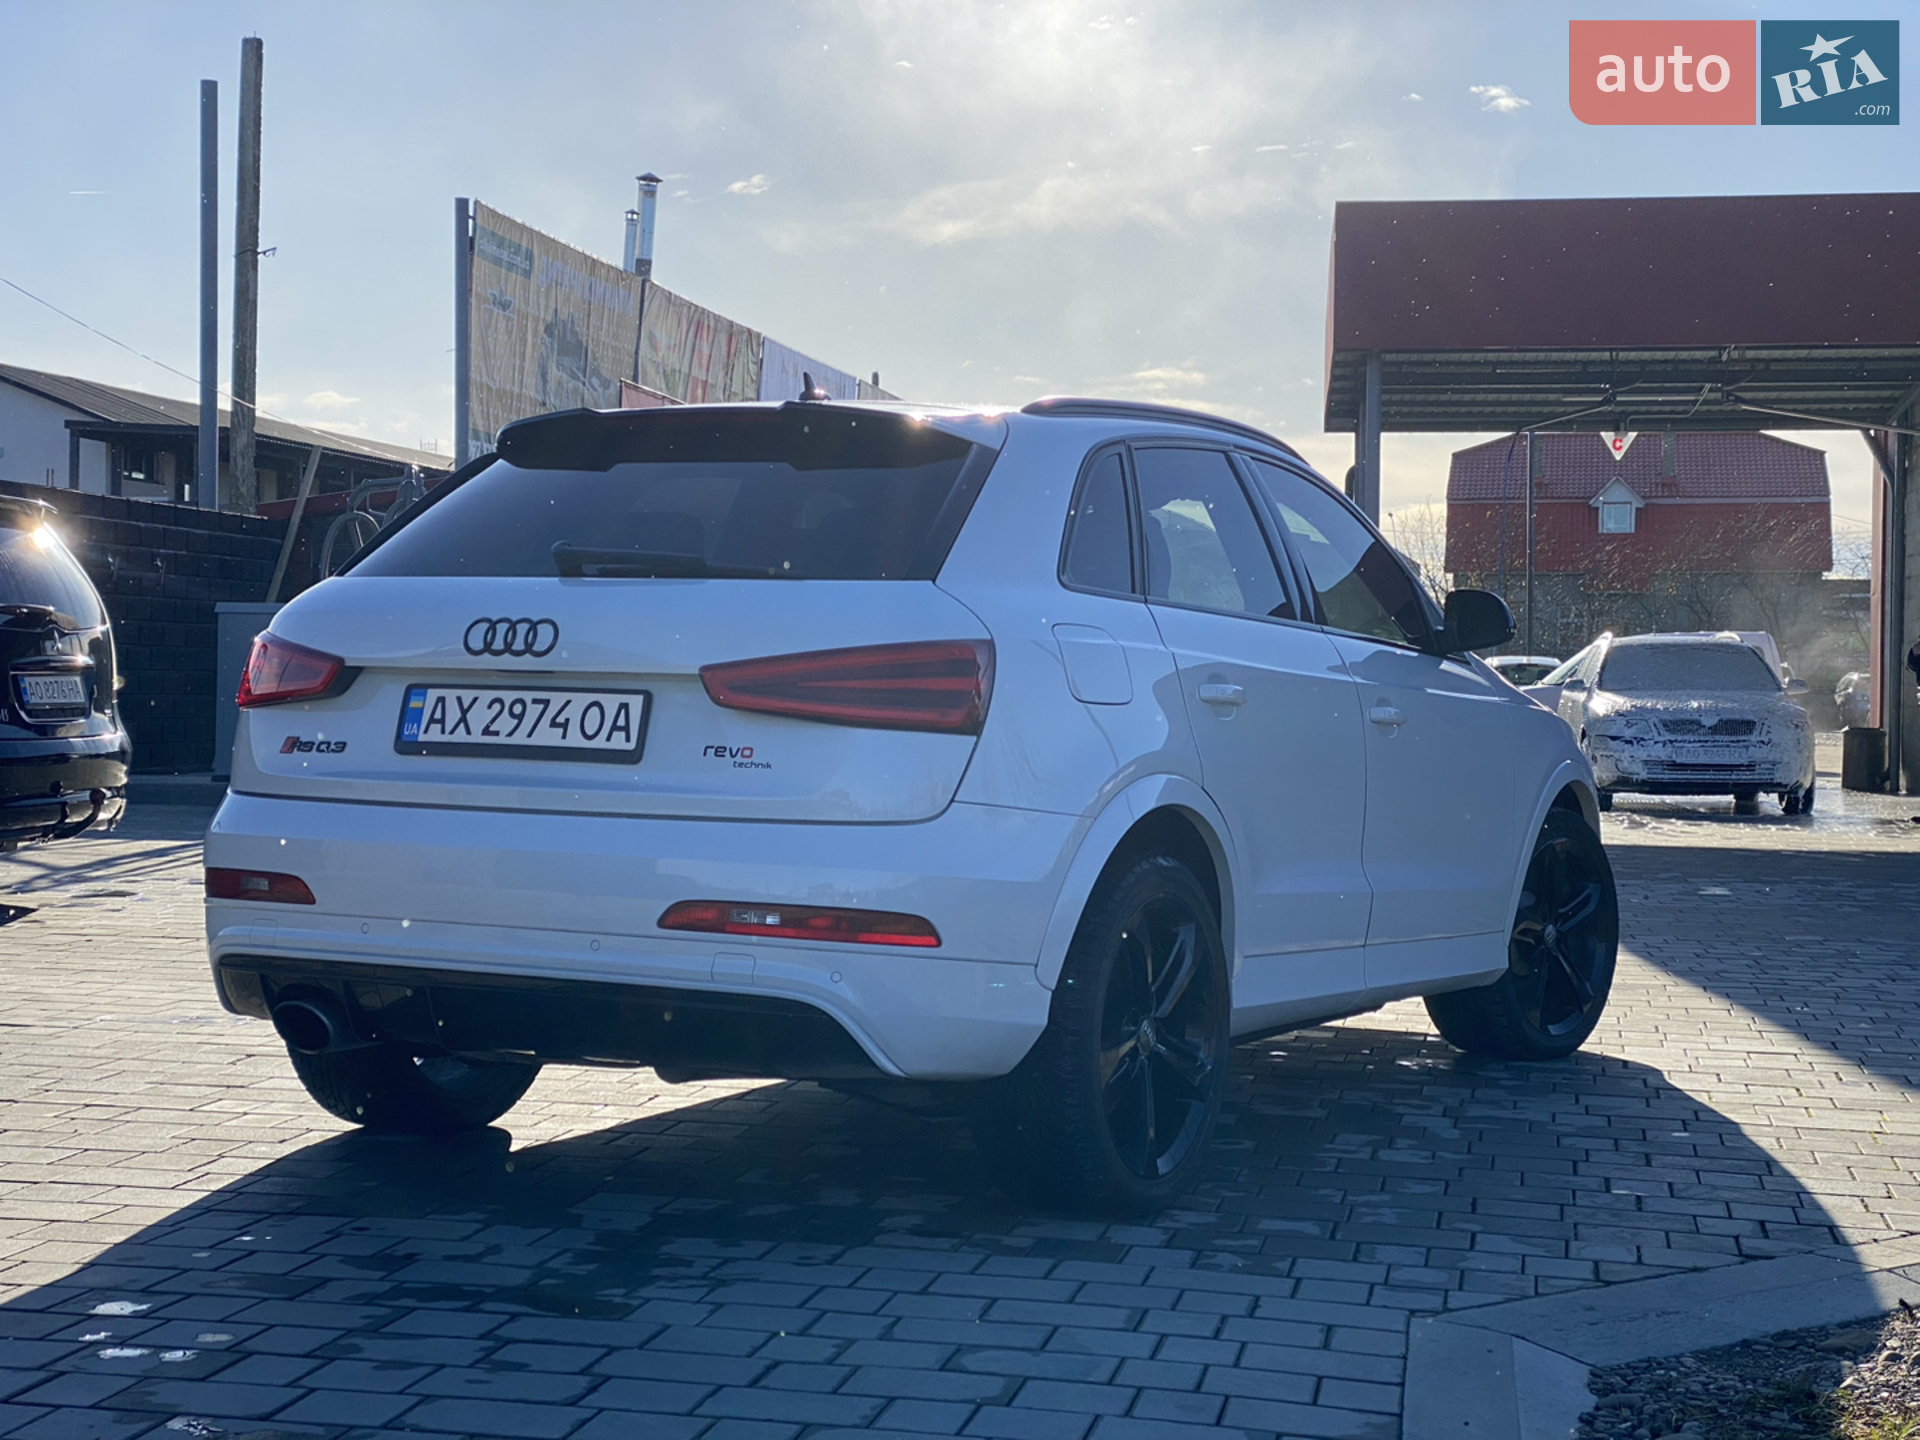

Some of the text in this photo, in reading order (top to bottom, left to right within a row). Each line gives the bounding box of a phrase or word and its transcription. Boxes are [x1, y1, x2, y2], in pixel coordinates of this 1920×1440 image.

[1612, 437, 1625, 451] C
[403, 723, 418, 735] UA
[702, 745, 754, 759] revo
[732, 760, 772, 769] technik
